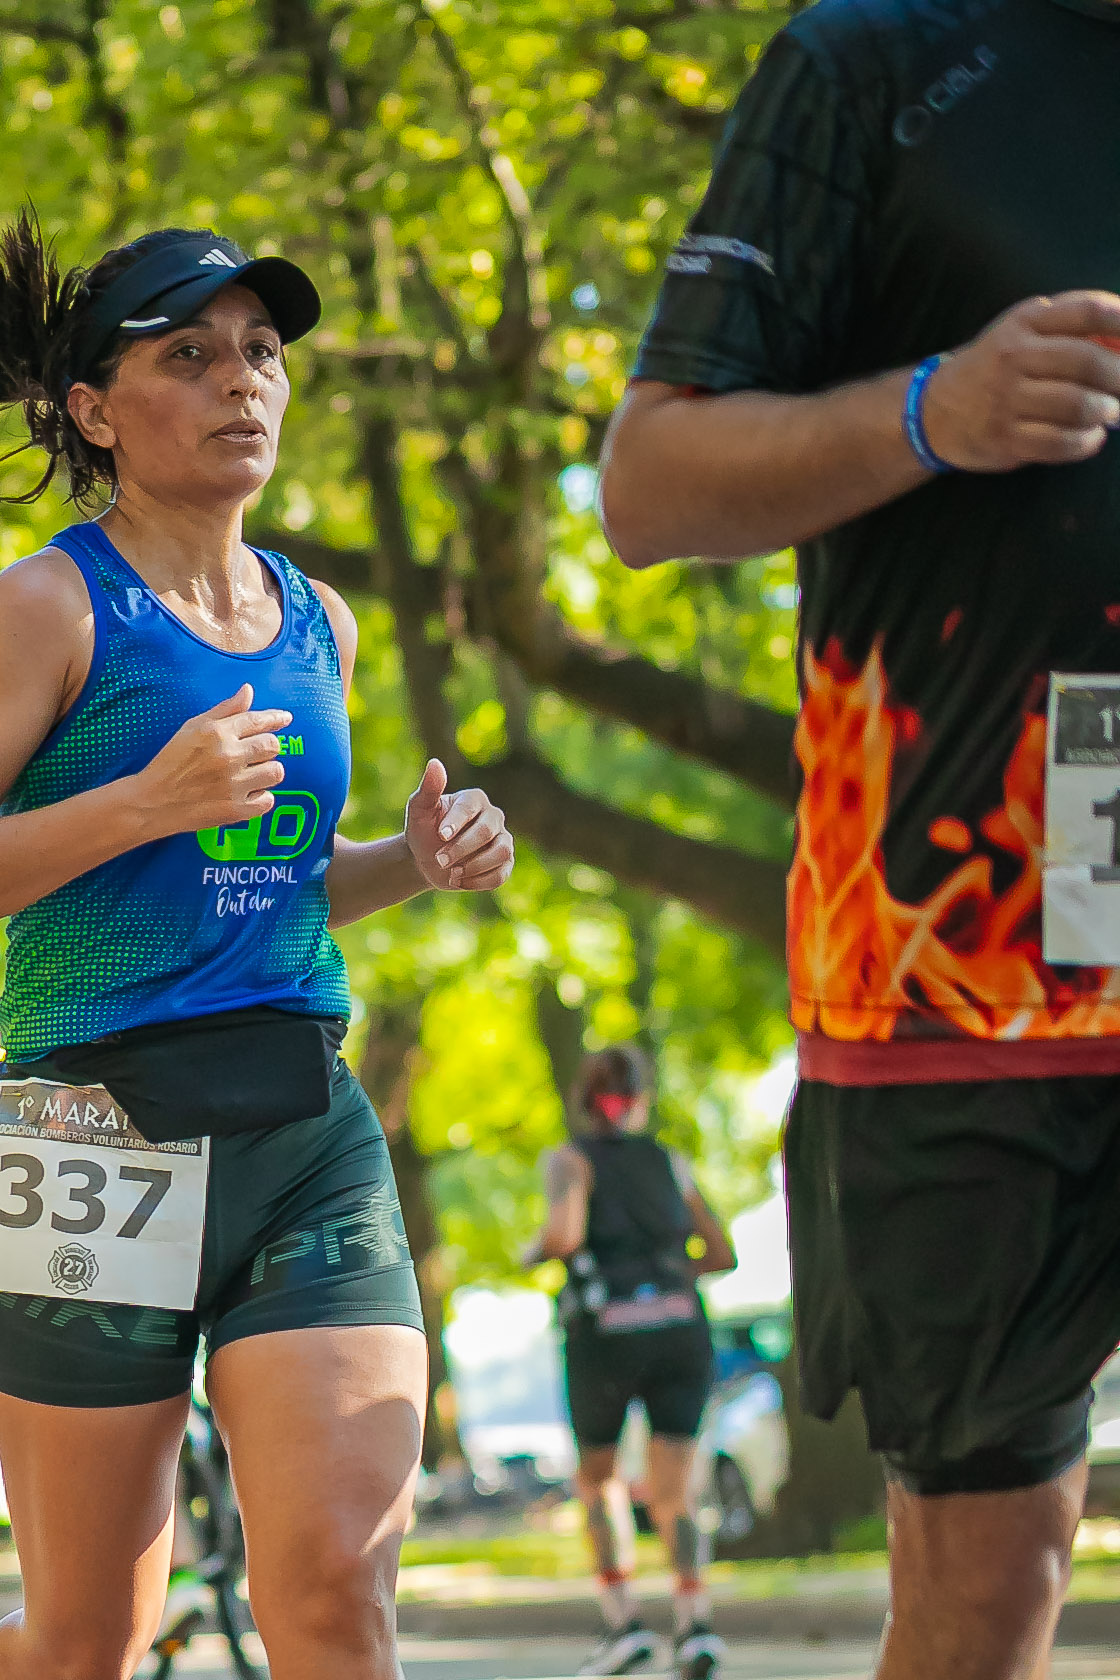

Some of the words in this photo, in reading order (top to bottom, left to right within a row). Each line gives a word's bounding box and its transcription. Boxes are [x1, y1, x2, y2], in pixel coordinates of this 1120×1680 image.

[39, 1127, 92, 1144] BOMBEROS
[92, 1134, 156, 1150] VOLUNTARIOS
[157, 1141, 199, 1155] ROSARIO
[63, 1257, 85, 1276] 27
